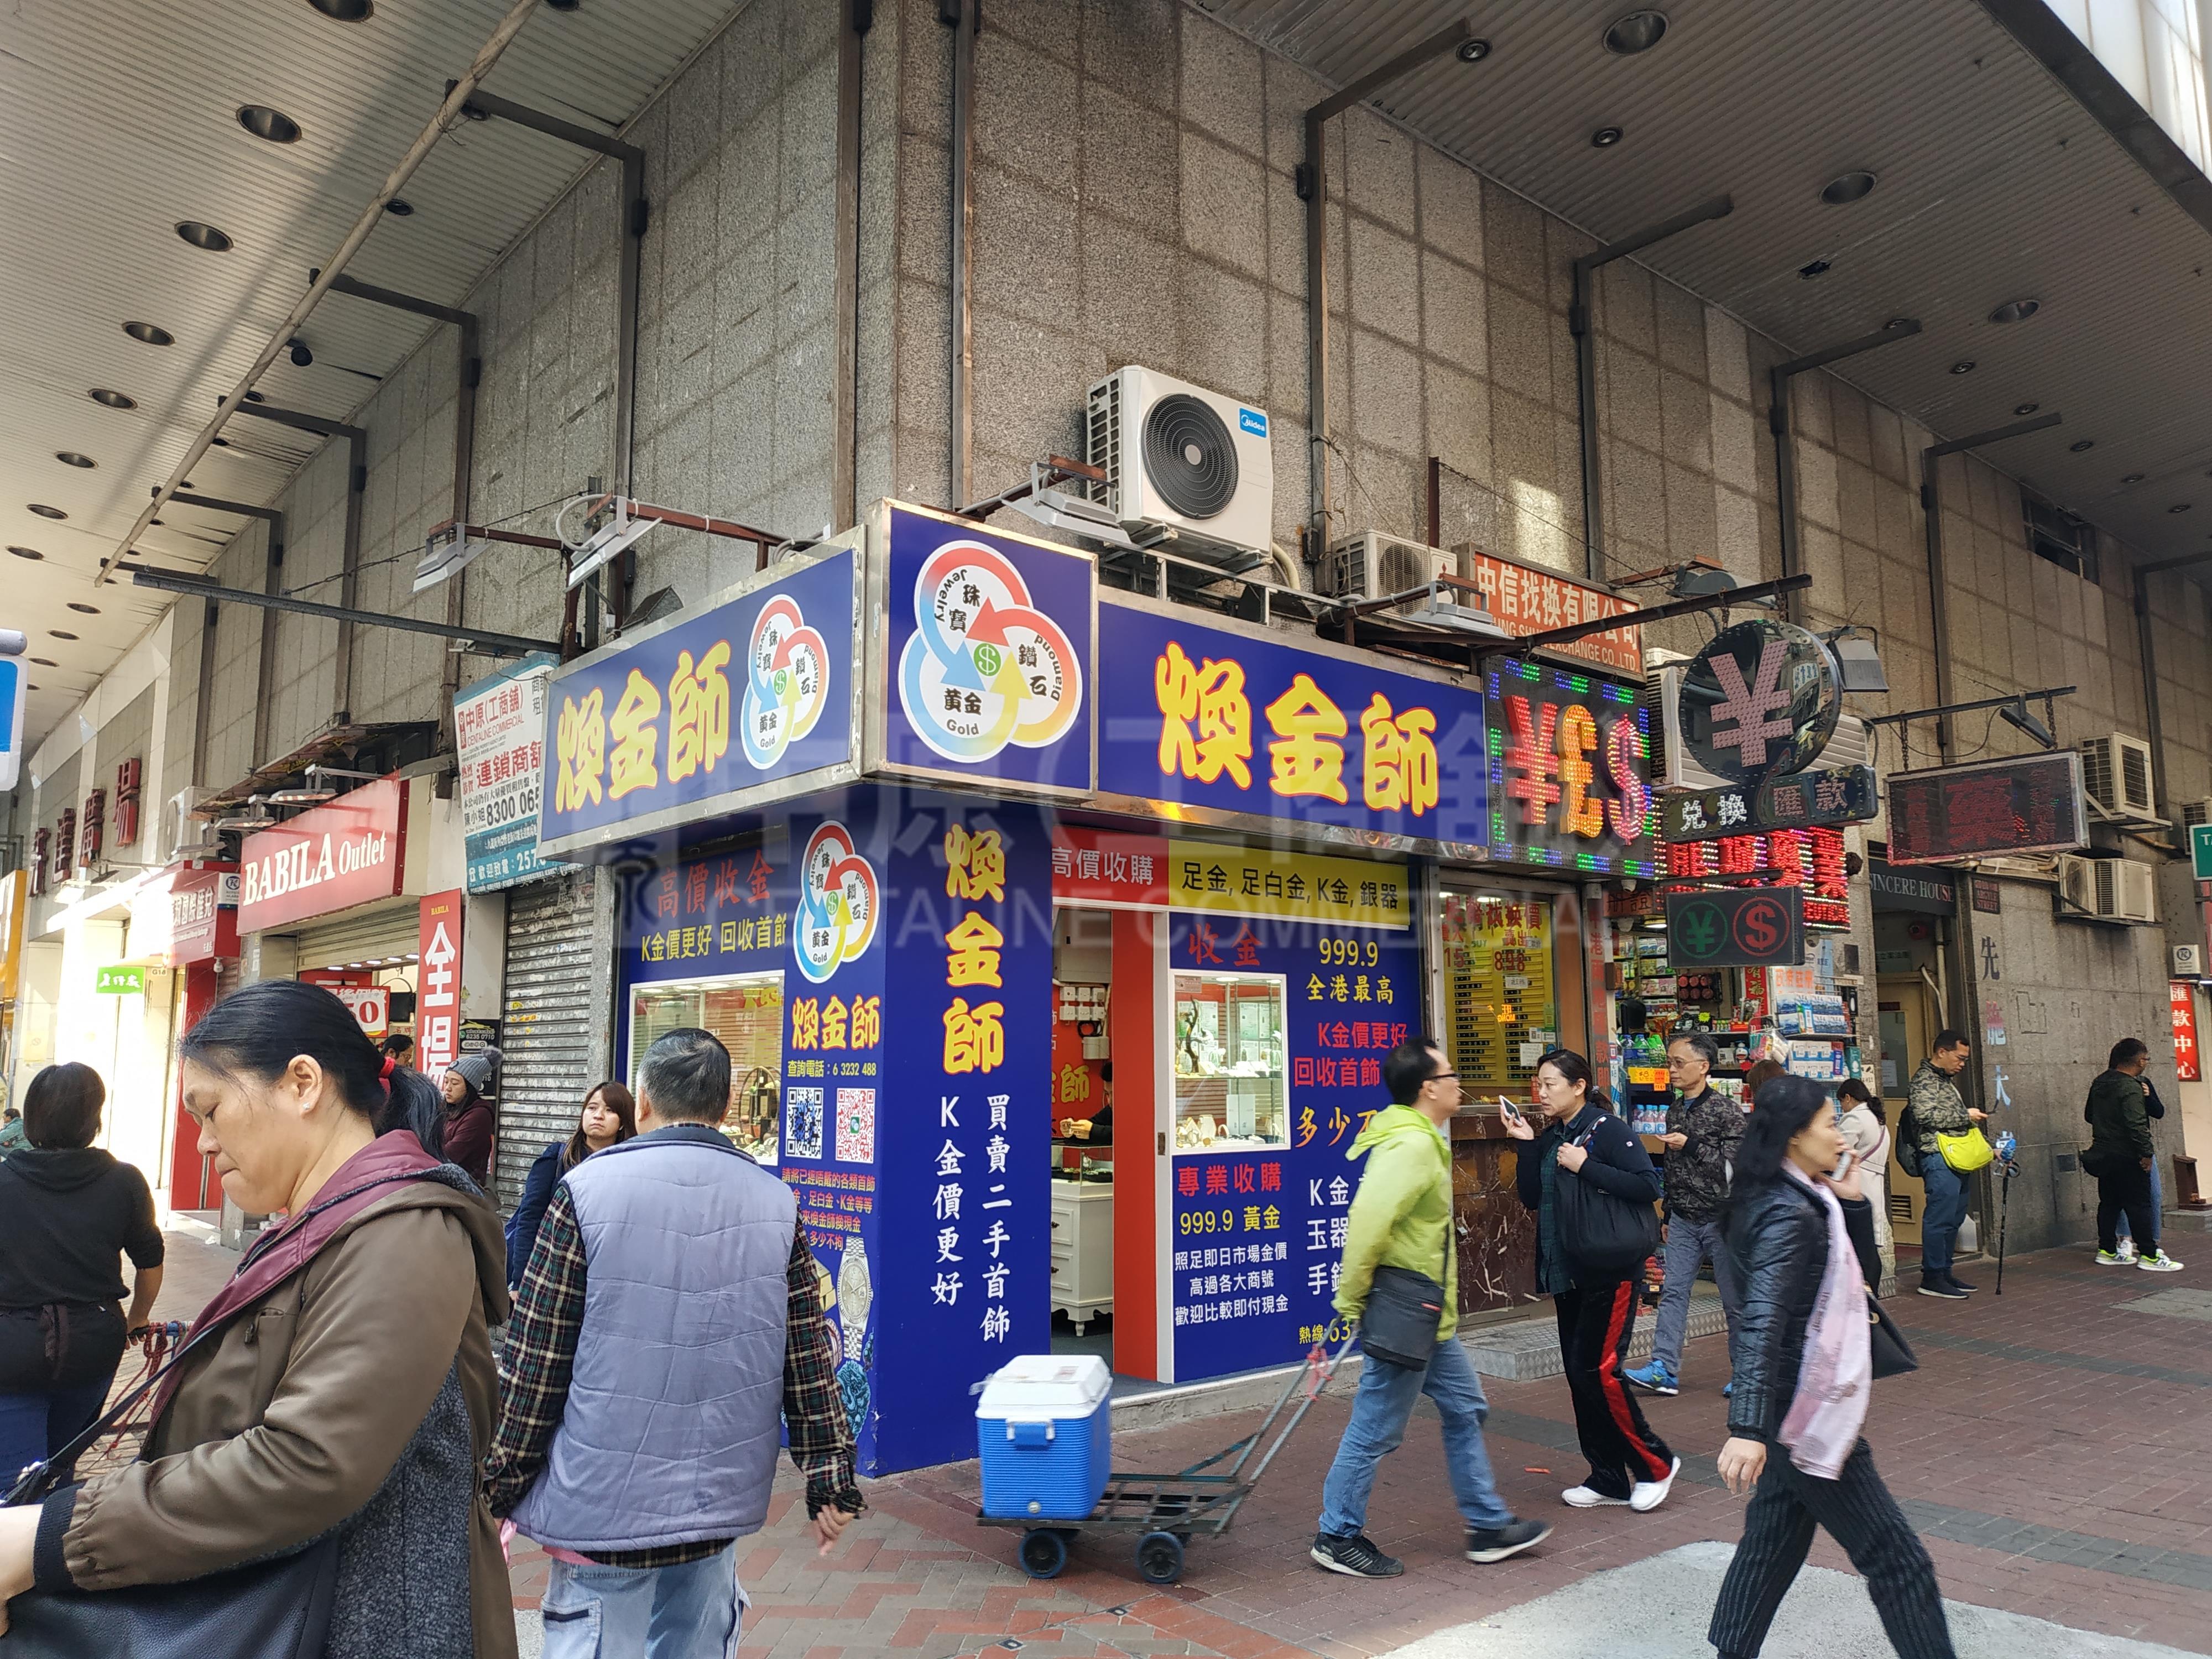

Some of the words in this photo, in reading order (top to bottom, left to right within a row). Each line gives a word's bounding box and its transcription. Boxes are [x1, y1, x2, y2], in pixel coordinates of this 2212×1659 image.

[1241, 415, 1266, 431] Midea
[933, 568, 968, 623] Jewelry
[948, 584, 980, 633] 珠寶
[757, 620, 772, 669] Jewelry
[804, 645, 819, 693] Diamond
[1018, 644, 1048, 697] 鑽石
[1034, 634, 1062, 702] Diamond
[943, 688, 982, 716] 黃金
[467, 727, 493, 747] CENTALINE
[492, 713, 525, 736] COMMERCIAL
[759, 712, 778, 733] 黃金
[946, 719, 980, 736] Gold
[760, 736, 775, 748] Gold
[486, 795, 515, 826] 8300
[243, 832, 336, 907] BABILA
[338, 830, 387, 875] Outlet
[1051, 846, 1154, 886] 高價收購
[657, 849, 775, 920] 高價收金
[855, 873, 869, 921] Diamond
[1360, 880, 1399, 910] 銀器
[1869, 873, 1917, 897] SINCERE
[1919, 880, 1954, 902] HOUSE
[430, 905, 450, 916] BABILA
[1976, 900, 1997, 911] STREET
[641, 925, 713, 962] K金價更好
[812, 930, 830, 948] 黃金
[1187, 922, 1263, 968] 收金
[1319, 938, 1379, 968] 999.9
[813, 952, 828, 964] Gold
[1305, 973, 1395, 1005] 全港最高
[1318, 1021, 1408, 1050] K金價更好
[2170, 985, 2195, 1079] 匯款中心
[841, 1062, 859, 1076] 3232
[862, 1062, 877, 1076] 488
[1294, 1057, 1381, 1088] 回收首飾
[1177, 1161, 1282, 1197] 專業收購
[930, 1095, 967, 1307] K金價更好
[979, 1094, 1013, 1344] 買賣二手首飾
[1180, 1209, 1234, 1236] 999.9
[1243, 1204, 1281, 1232] 黃金
[1175, 1241, 1288, 1272] 照足即日市場金價
[1189, 1269, 1275, 1298] 高過各大商號
[1175, 1293, 1290, 1327] 歡迎比較即付現金
